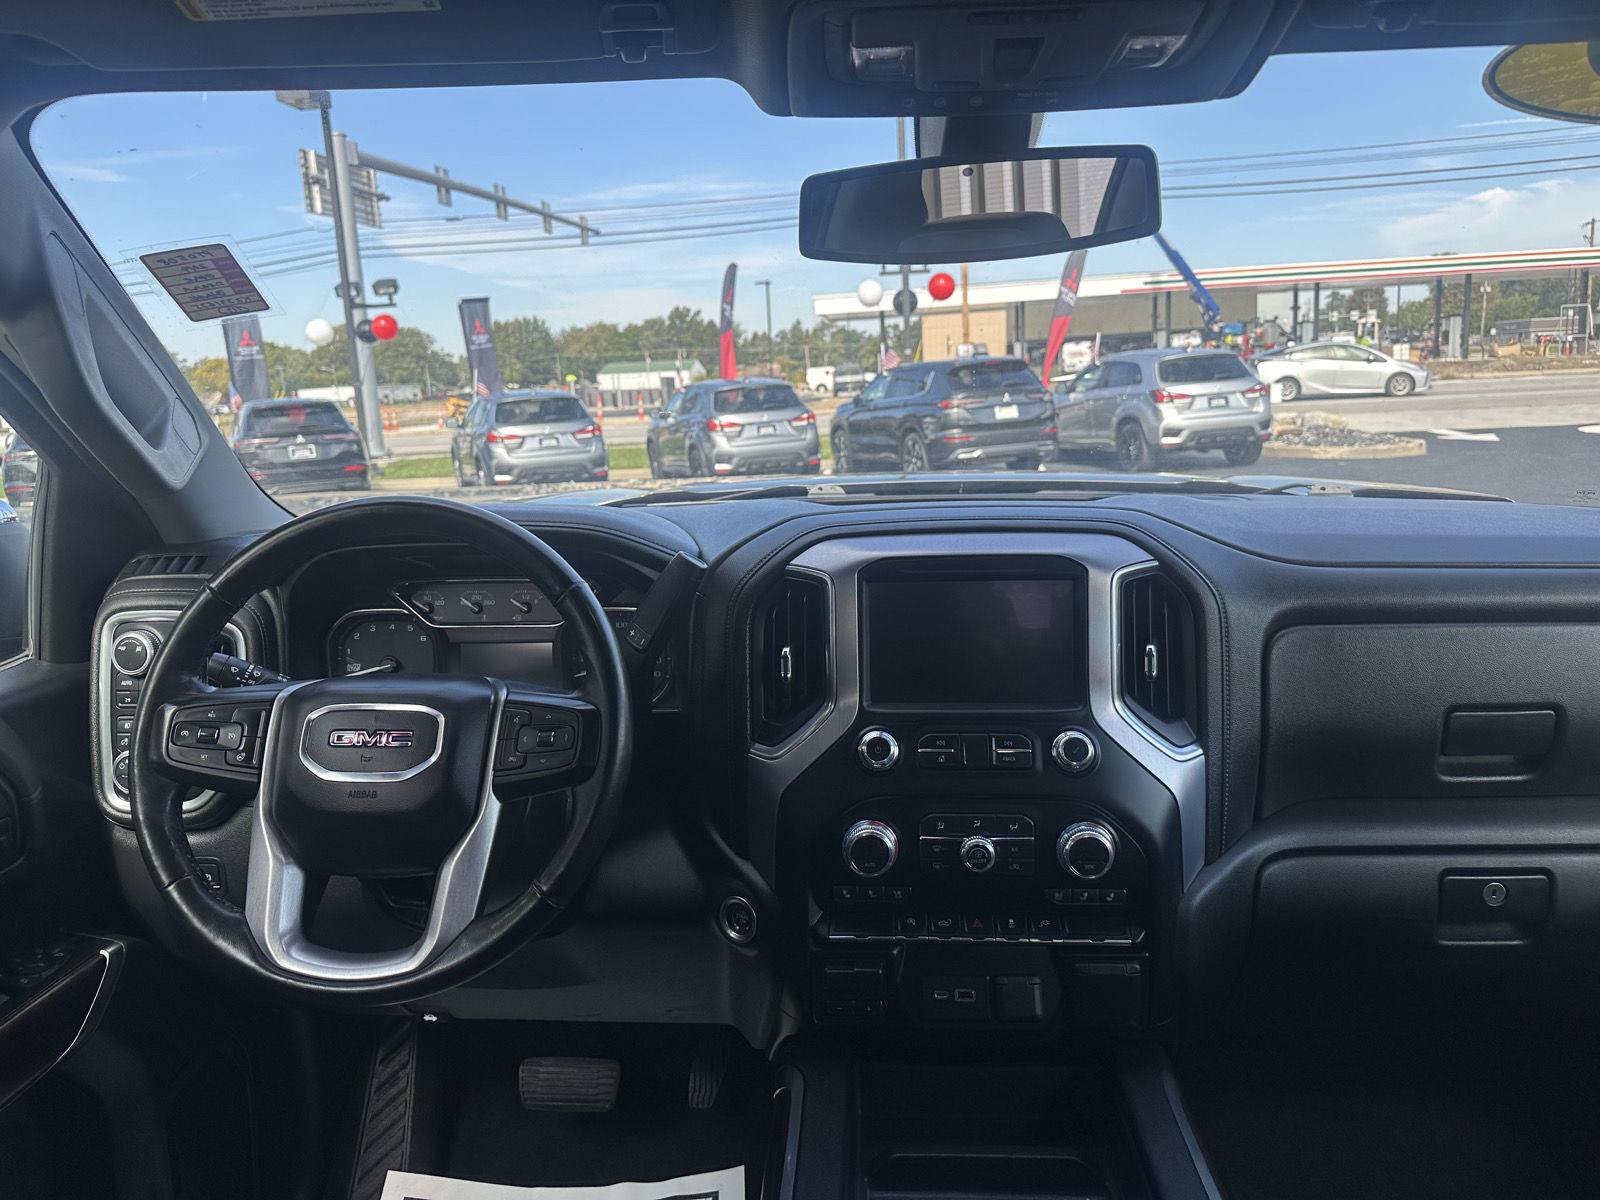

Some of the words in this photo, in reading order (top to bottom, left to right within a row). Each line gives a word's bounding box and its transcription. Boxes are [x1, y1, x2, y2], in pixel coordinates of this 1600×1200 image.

[353, 632, 361, 640] 2
[329, 729, 414, 748] GMC
[347, 790, 378, 799] AIRBAG
